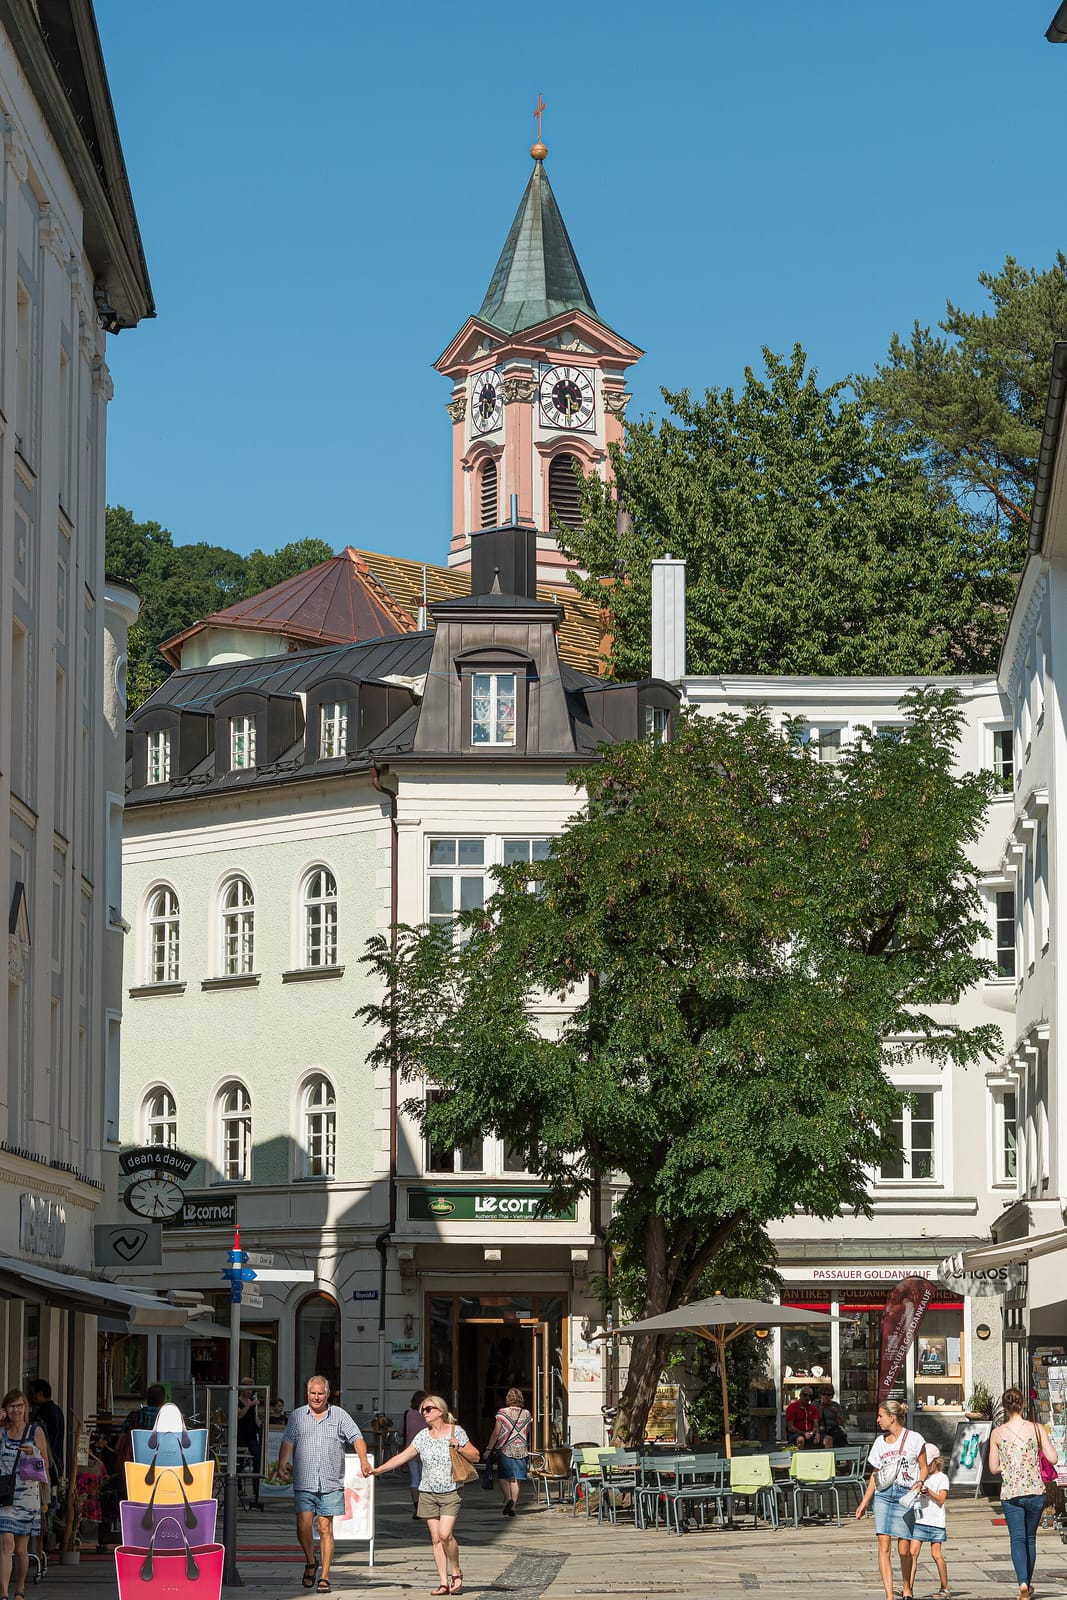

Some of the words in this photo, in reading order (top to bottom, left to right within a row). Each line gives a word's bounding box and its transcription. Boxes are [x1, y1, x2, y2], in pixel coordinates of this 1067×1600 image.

[813, 1270, 862, 1279] PASSAUER
[864, 1270, 932, 1279] GOLDANKAUF
[783, 1289, 830, 1299] ANTIKES
[883, 1344, 908, 1387] PASSAUER
[903, 1288, 932, 1345] GOLDANKAUF
